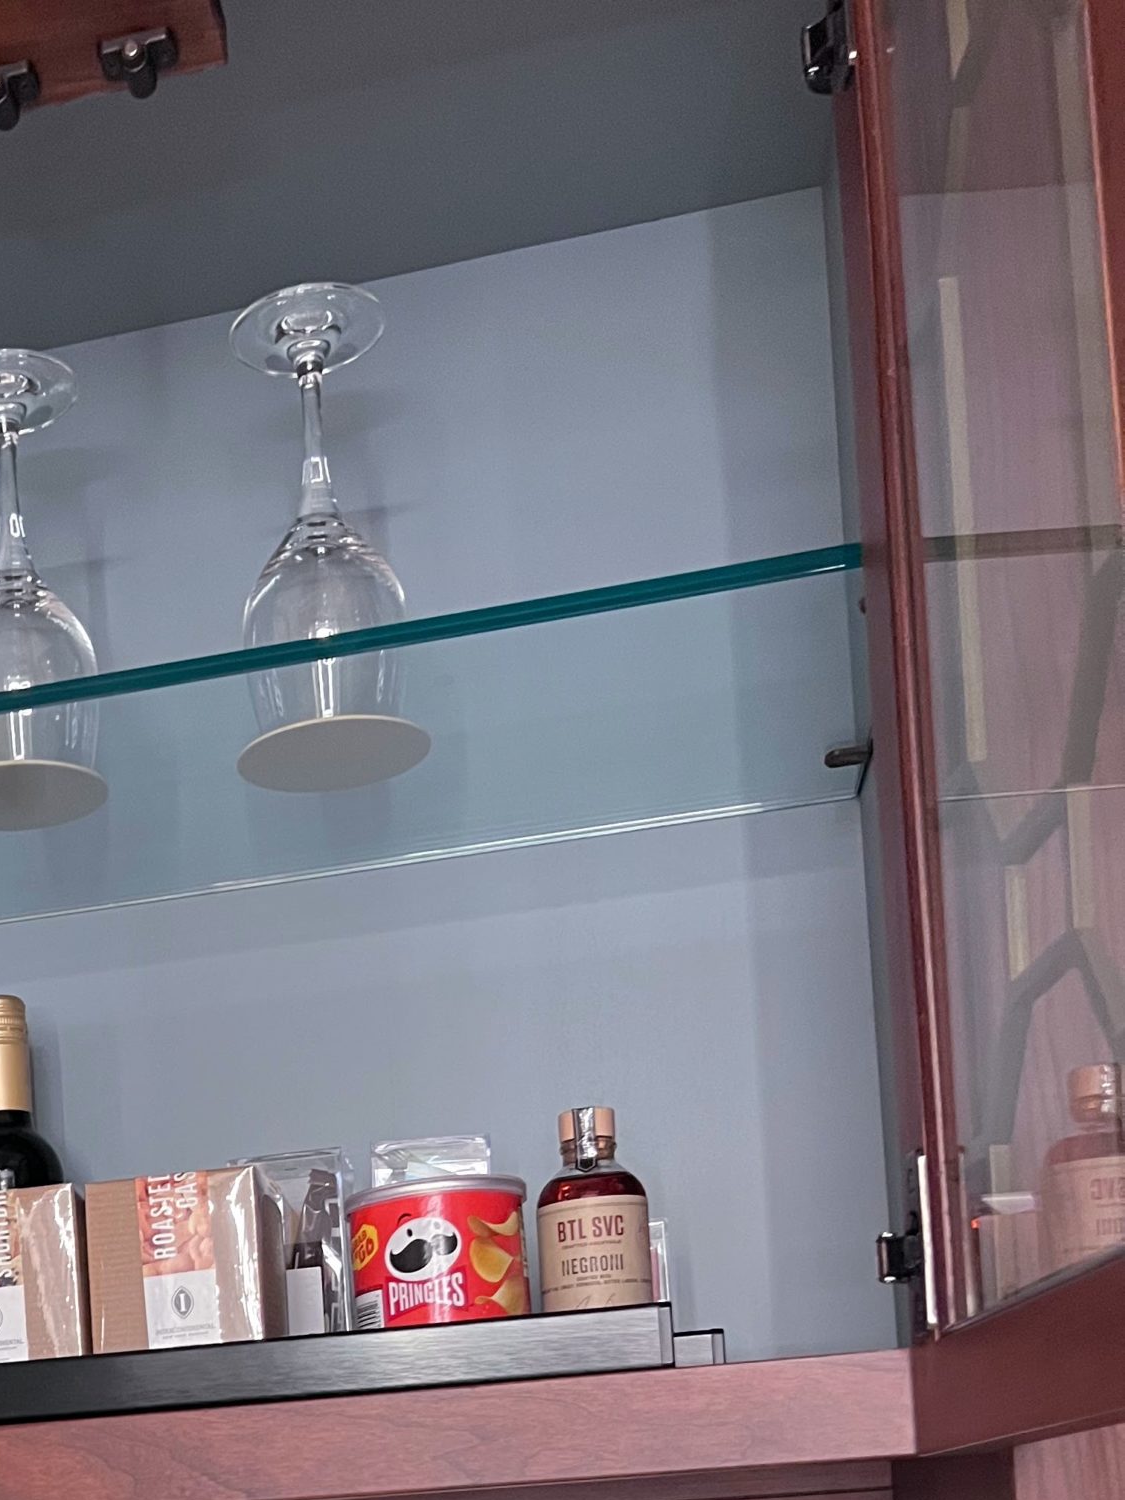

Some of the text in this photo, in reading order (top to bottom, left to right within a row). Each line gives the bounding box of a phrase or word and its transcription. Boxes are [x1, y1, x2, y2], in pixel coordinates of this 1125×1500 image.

[557, 1214, 625, 1243] BTL SVC
[561, 1253, 624, 1277] NEGRONI
[388, 1271, 465, 1317] PRINGLES
